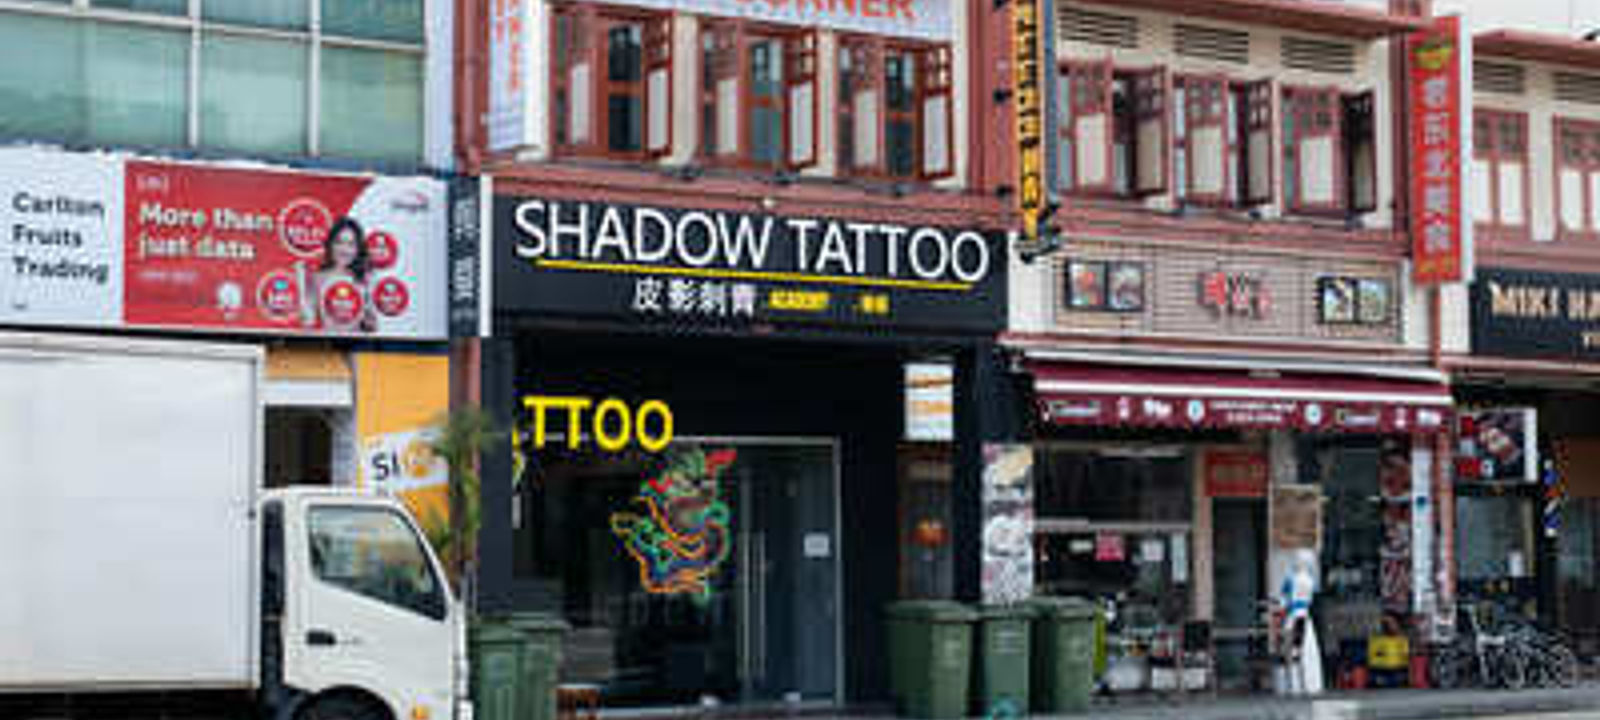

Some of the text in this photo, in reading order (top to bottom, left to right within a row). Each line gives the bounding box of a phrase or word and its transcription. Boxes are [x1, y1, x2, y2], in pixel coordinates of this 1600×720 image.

[140, 201, 274, 233] More than
[12, 223, 83, 248] Fruits
[139, 231, 257, 261] just data
[515, 198, 773, 268] SHADOW
[788, 218, 989, 283] TATTOO
[12, 255, 109, 286] Trading
